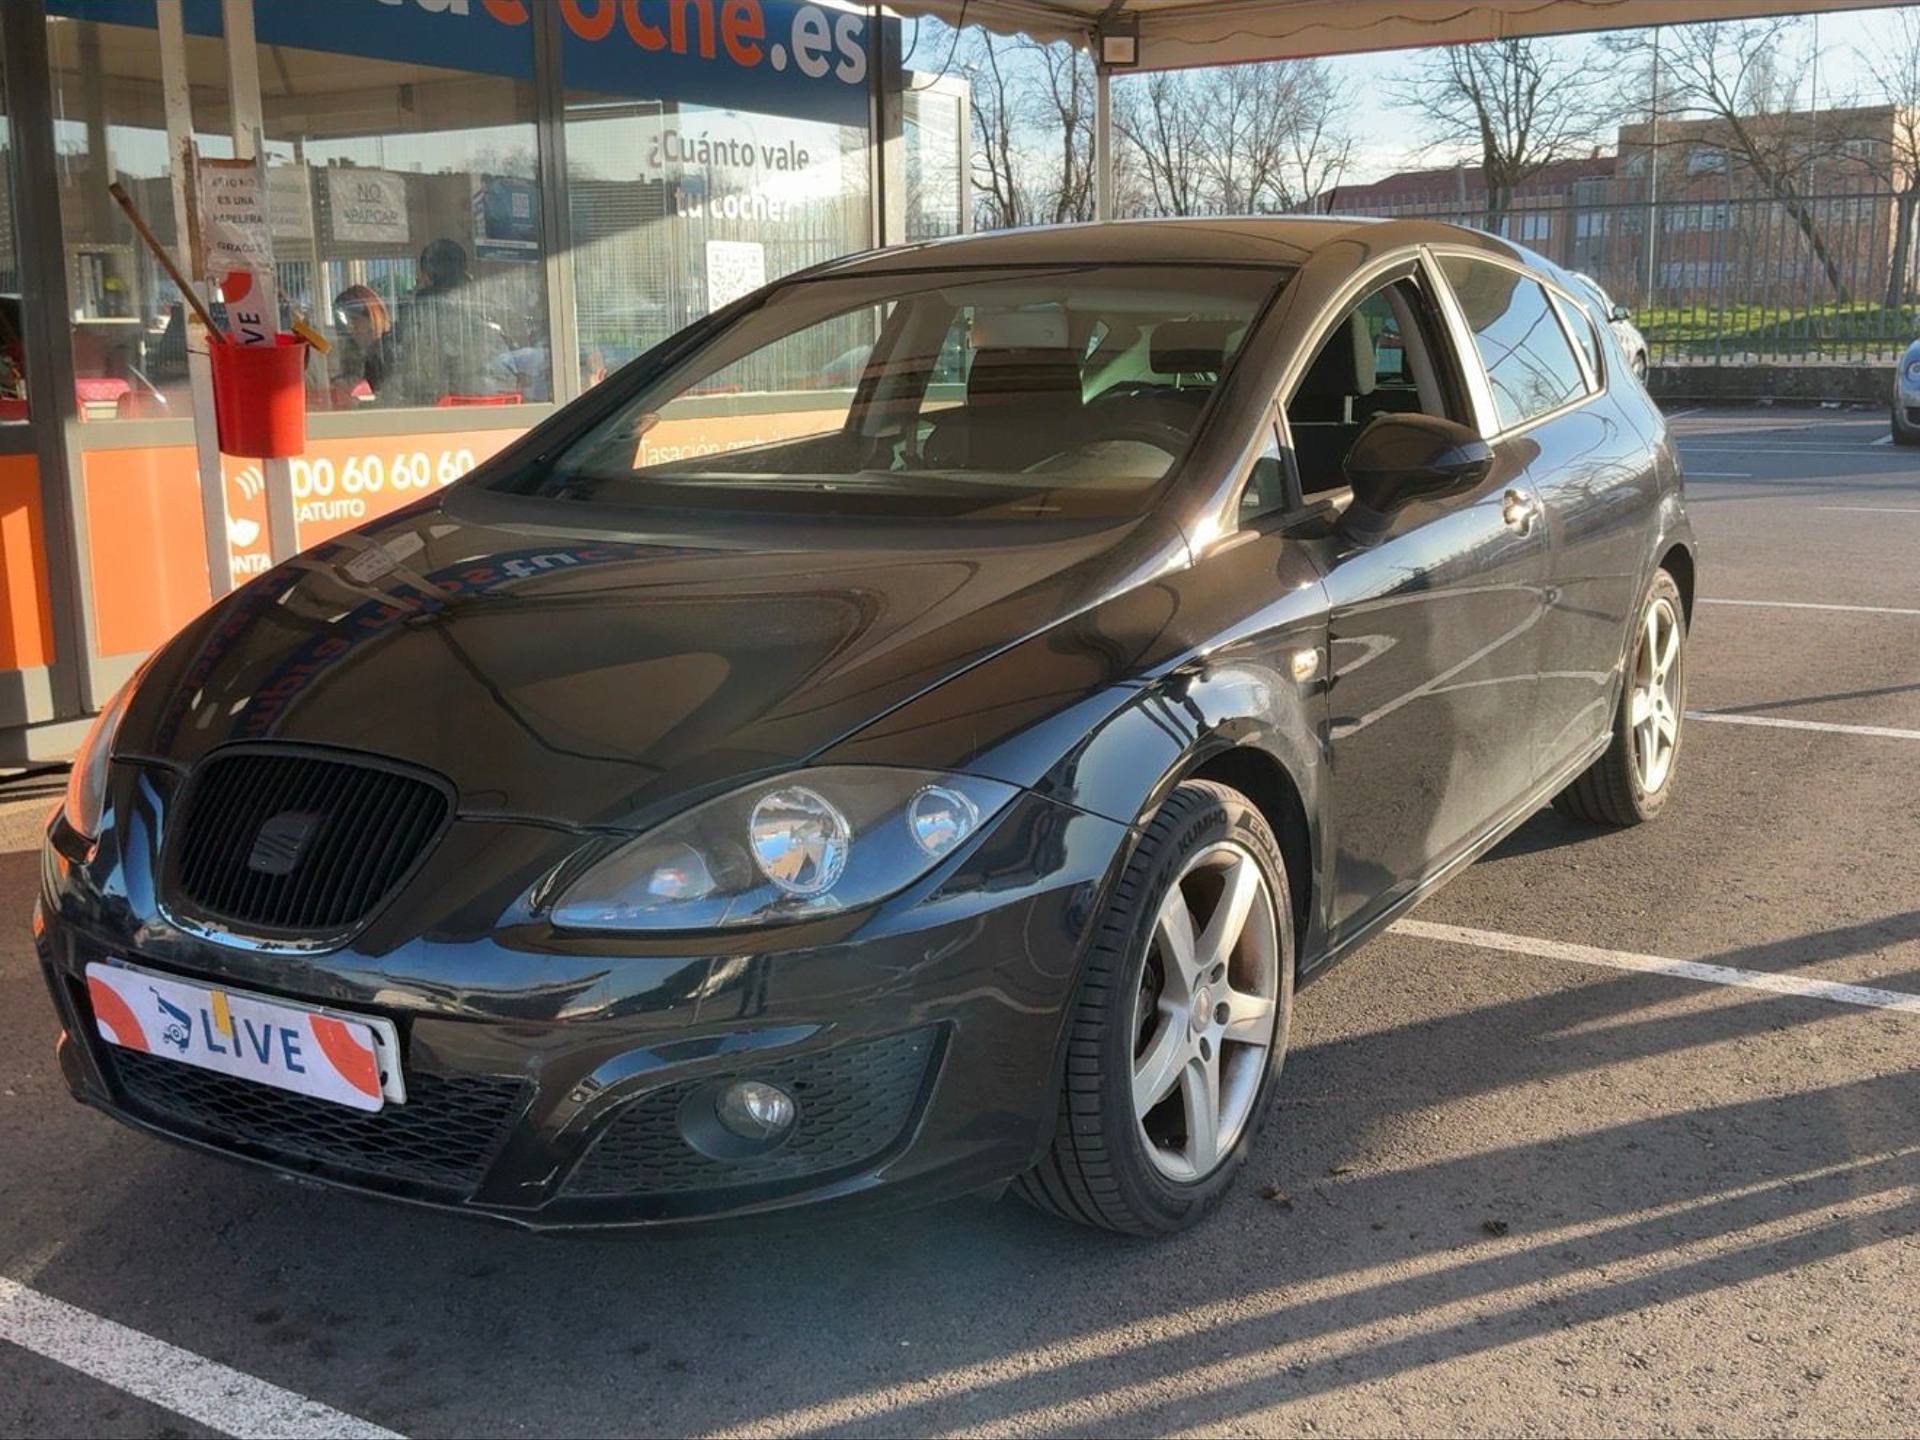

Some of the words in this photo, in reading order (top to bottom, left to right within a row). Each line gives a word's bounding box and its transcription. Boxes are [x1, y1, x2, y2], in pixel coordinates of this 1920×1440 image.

[648, 129, 755, 168] ¿Cuánto
[761, 140, 809, 171] vale
[357, 182, 381, 199] NO
[342, 455, 384, 493] 60
[391, 452, 430, 488] 60
[437, 449, 476, 485] 60
[200, 1008, 306, 1074] LIVE
